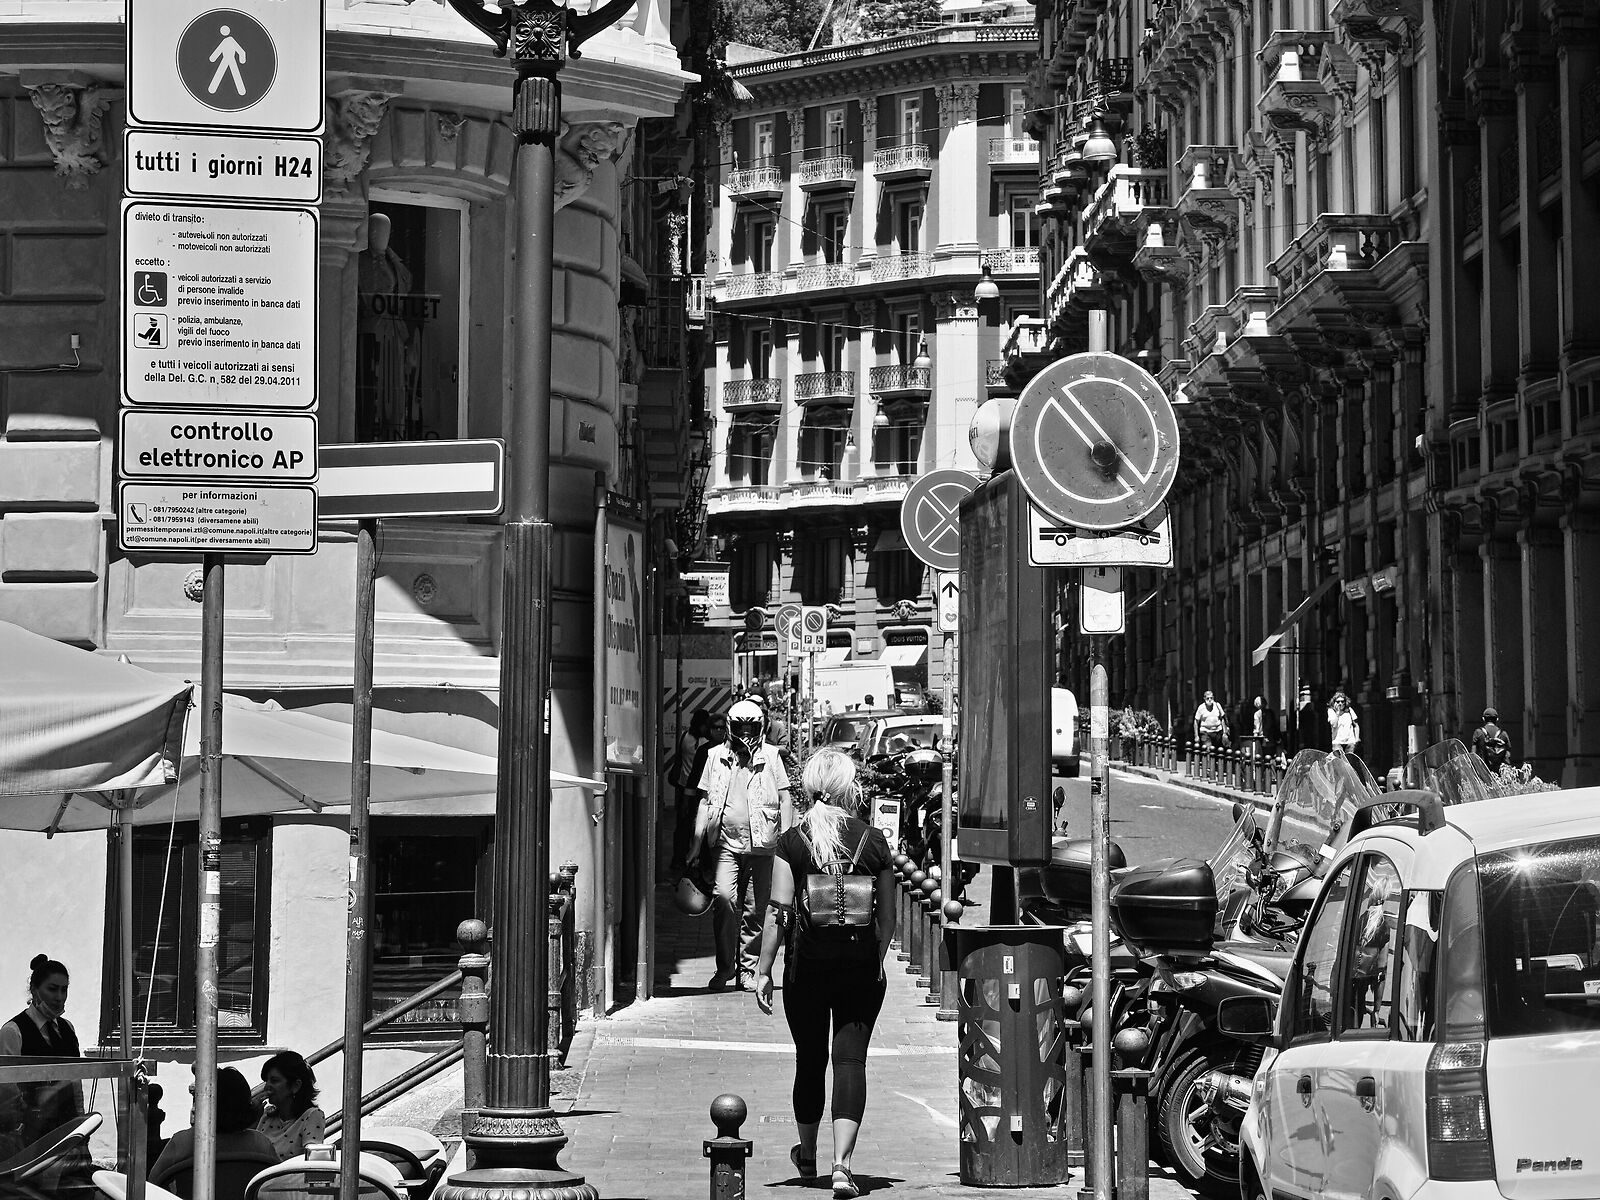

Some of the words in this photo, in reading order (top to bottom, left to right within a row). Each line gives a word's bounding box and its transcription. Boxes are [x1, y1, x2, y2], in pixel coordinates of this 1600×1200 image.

[134, 150, 180, 172] tutti
[191, 152, 197, 173] i
[208, 153, 262, 179] giorni
[275, 155, 313, 178] H24
[135, 212, 160, 222] divieto
[163, 213, 170, 222] di
[172, 213, 205, 224] transito:
[177, 231, 215, 240] autoveicoli
[216, 233, 230, 241] non
[231, 233, 268, 242] autorizzati
[177, 243, 218, 252] motoveicoli
[219, 244, 233, 252] non
[234, 245, 271, 254] autorizzati
[135, 257, 165, 266] eccetto
[177, 273, 200, 282] veicoli
[201, 274, 237, 283] autorizzati
[245, 275, 272, 285] servizio
[177, 285, 185, 294] di
[186, 286, 216, 296] persone
[217, 285, 245, 295] invalide
[177, 297, 202, 307] previo
[204, 297, 250, 307] inserimento
[251, 299, 259, 308] in
[260, 299, 284, 309] banca
[285, 300, 301, 309] dati
[372, 294, 441, 320] OUTLET
[177, 316, 202, 325] polizia,
[204, 316, 243, 326] ambulanze,
[177, 327, 194, 336] vigili
[196, 327, 208, 336] del
[209, 327, 230, 336] fuoco
[177, 338, 202, 348] previo
[204, 338, 250, 348] inserimento
[251, 340, 259, 348] in
[260, 340, 284, 349] banca
[286, 341, 301, 350] dati
[158, 359, 176, 369] tutti
[183, 360, 212, 370] veicoli
[214, 361, 259, 372] autorizzati
[261, 362, 270, 372] ai
[271, 363, 295, 373] sensi
[144, 373, 166, 382] della
[168, 373, 186, 383] Del.
[188, 374, 207, 384] G.C.
[220, 375, 236, 384] 582
[238, 375, 252, 385] del
[254, 376, 300, 386] 29.04.2011
[170, 421, 274, 441] controllo
[139, 448, 264, 469] elettronico
[272, 450, 304, 469] AP
[182, 492, 198, 501] per
[200, 491, 258, 501] informazioni
[153, 506, 195, 514] 081/7950242
[195, 507, 214, 515] (altre
[214, 508, 247, 516] categorie)
[242, 517, 259, 525] abili)
[280, 528, 312, 537] categorie)
[209, 537, 253, 545] diversamente
[254, 537, 271, 545] abili)
[1516, 1156, 1583, 1173] Panda
